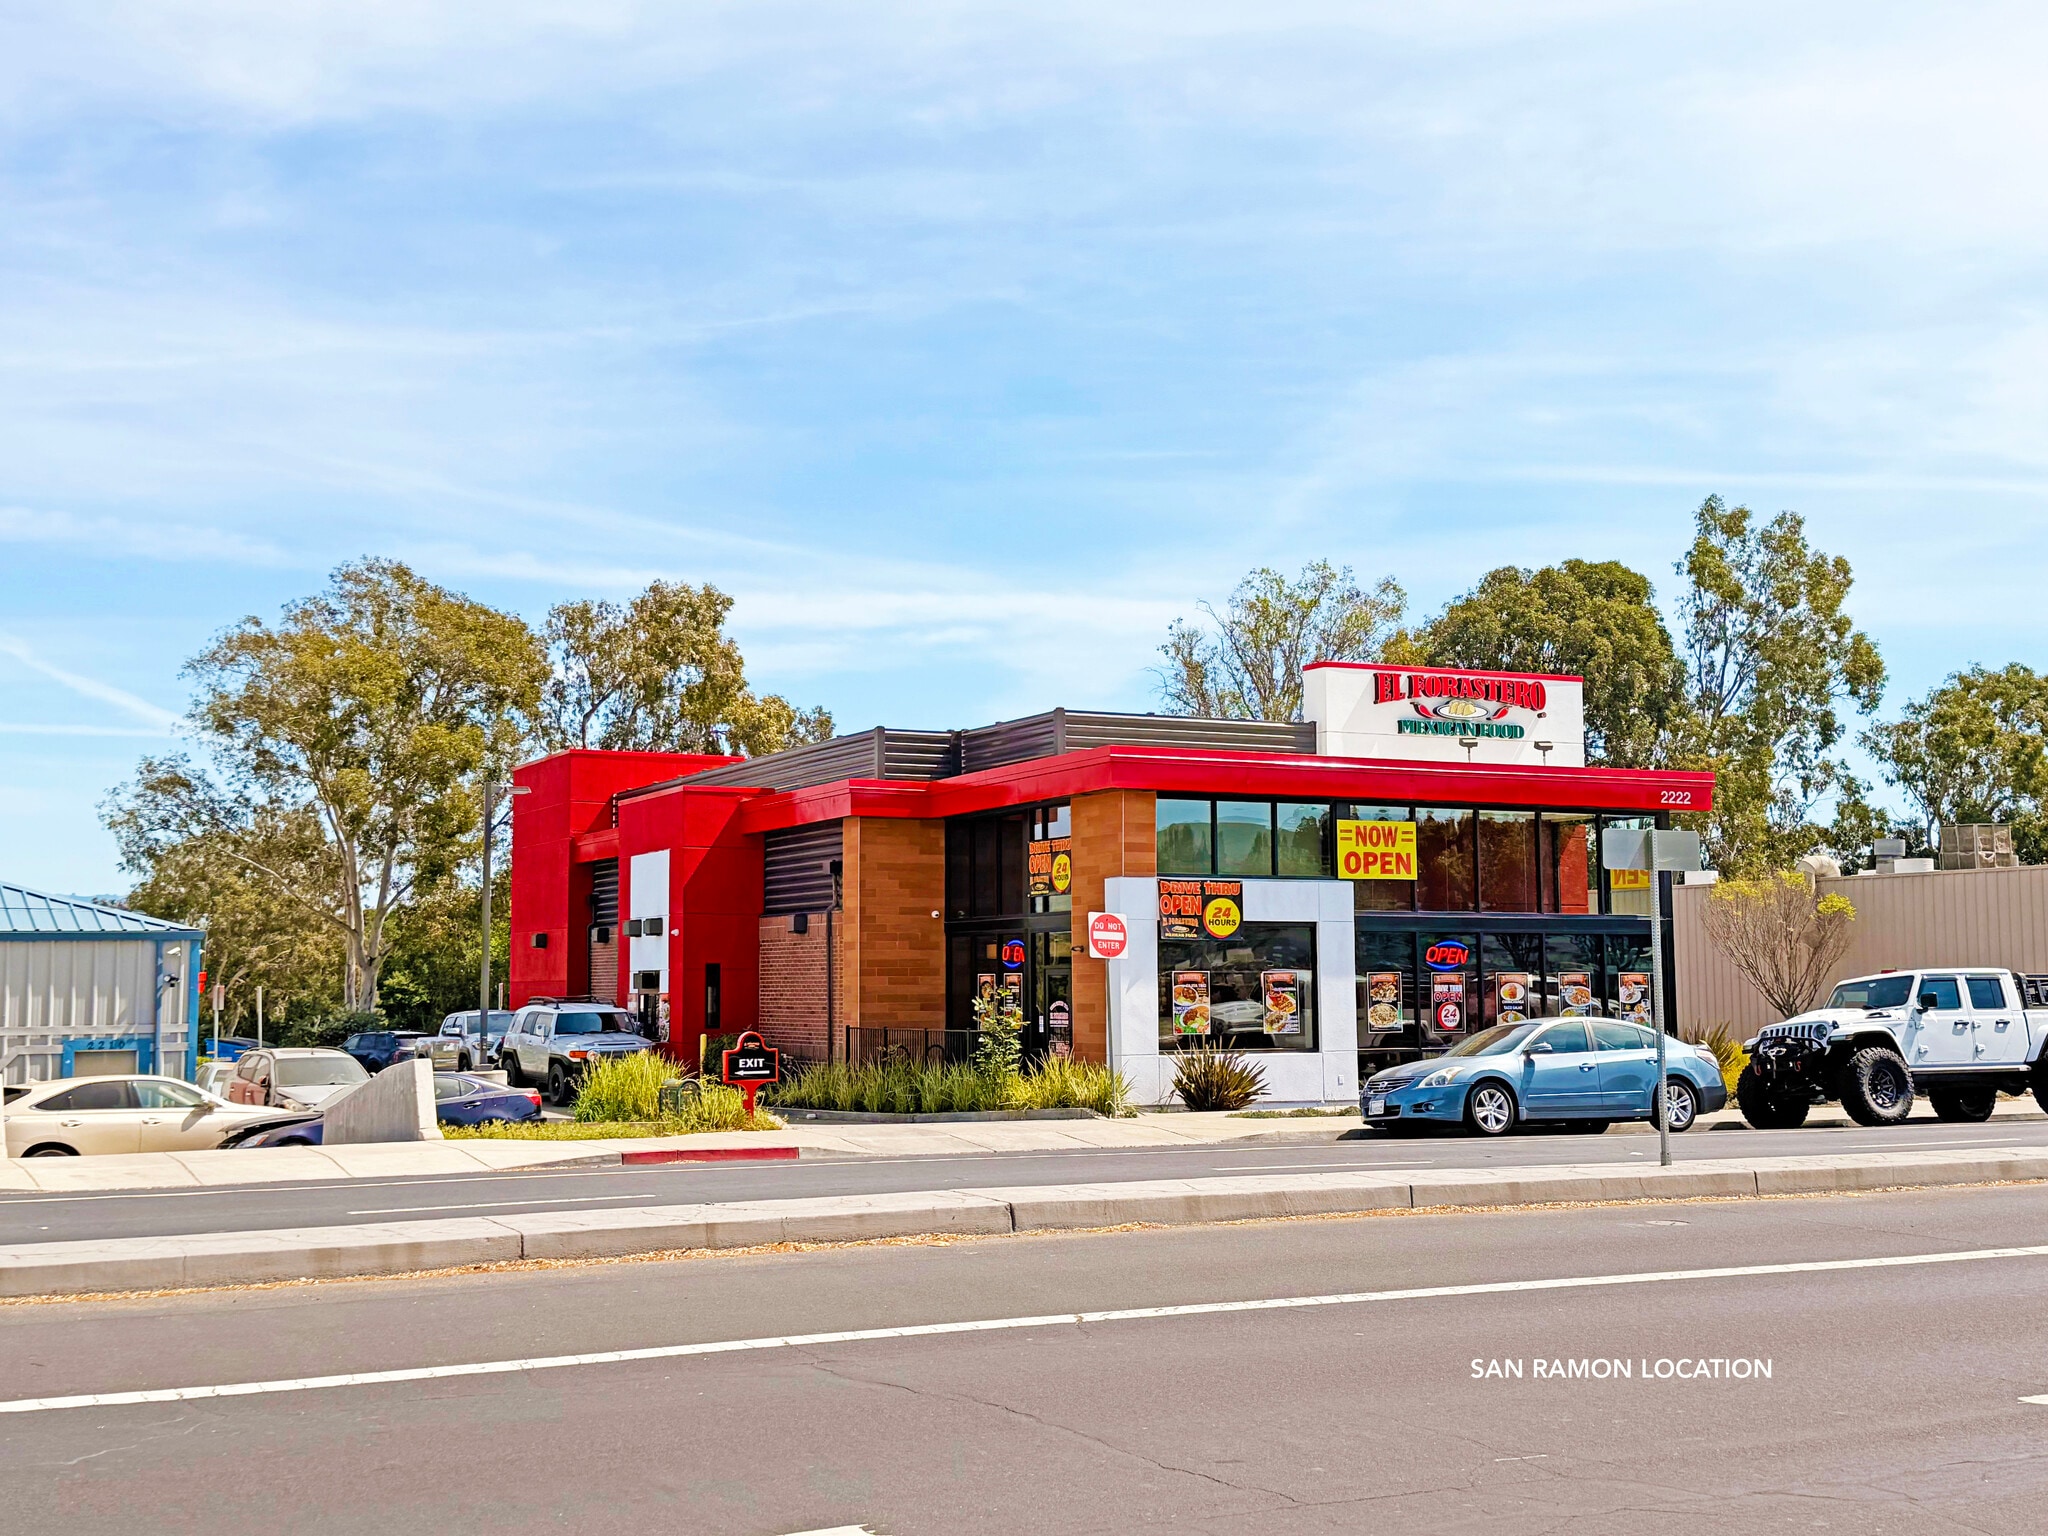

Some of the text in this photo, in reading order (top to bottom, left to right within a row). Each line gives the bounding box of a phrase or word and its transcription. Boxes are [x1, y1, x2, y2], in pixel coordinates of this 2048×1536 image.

[1374, 673, 1546, 711] EL FORASTERO
[1398, 720, 1525, 739] MEXICAN FOOD
[1660, 790, 1691, 805] 2222
[1355, 825, 1399, 848] NOW
[1029, 853, 1051, 874] OPEN
[1056, 862, 1068, 875] 24
[1344, 851, 1412, 875] OPEN
[1160, 881, 1240, 895] DRIVE THRU
[1160, 894, 1202, 915] OPEN
[1212, 907, 1232, 919] 24
[1094, 921, 1121, 930] DO NOT
[1208, 918, 1237, 926] HOURS
[1097, 941, 1120, 950] ENTER
[1002, 946, 1025, 963] OEN
[1426, 946, 1469, 966] OPEN
[1434, 992, 1463, 1002] OPEN
[1443, 1008, 1457, 1018] 24
[738, 1058, 765, 1068] EXIT
